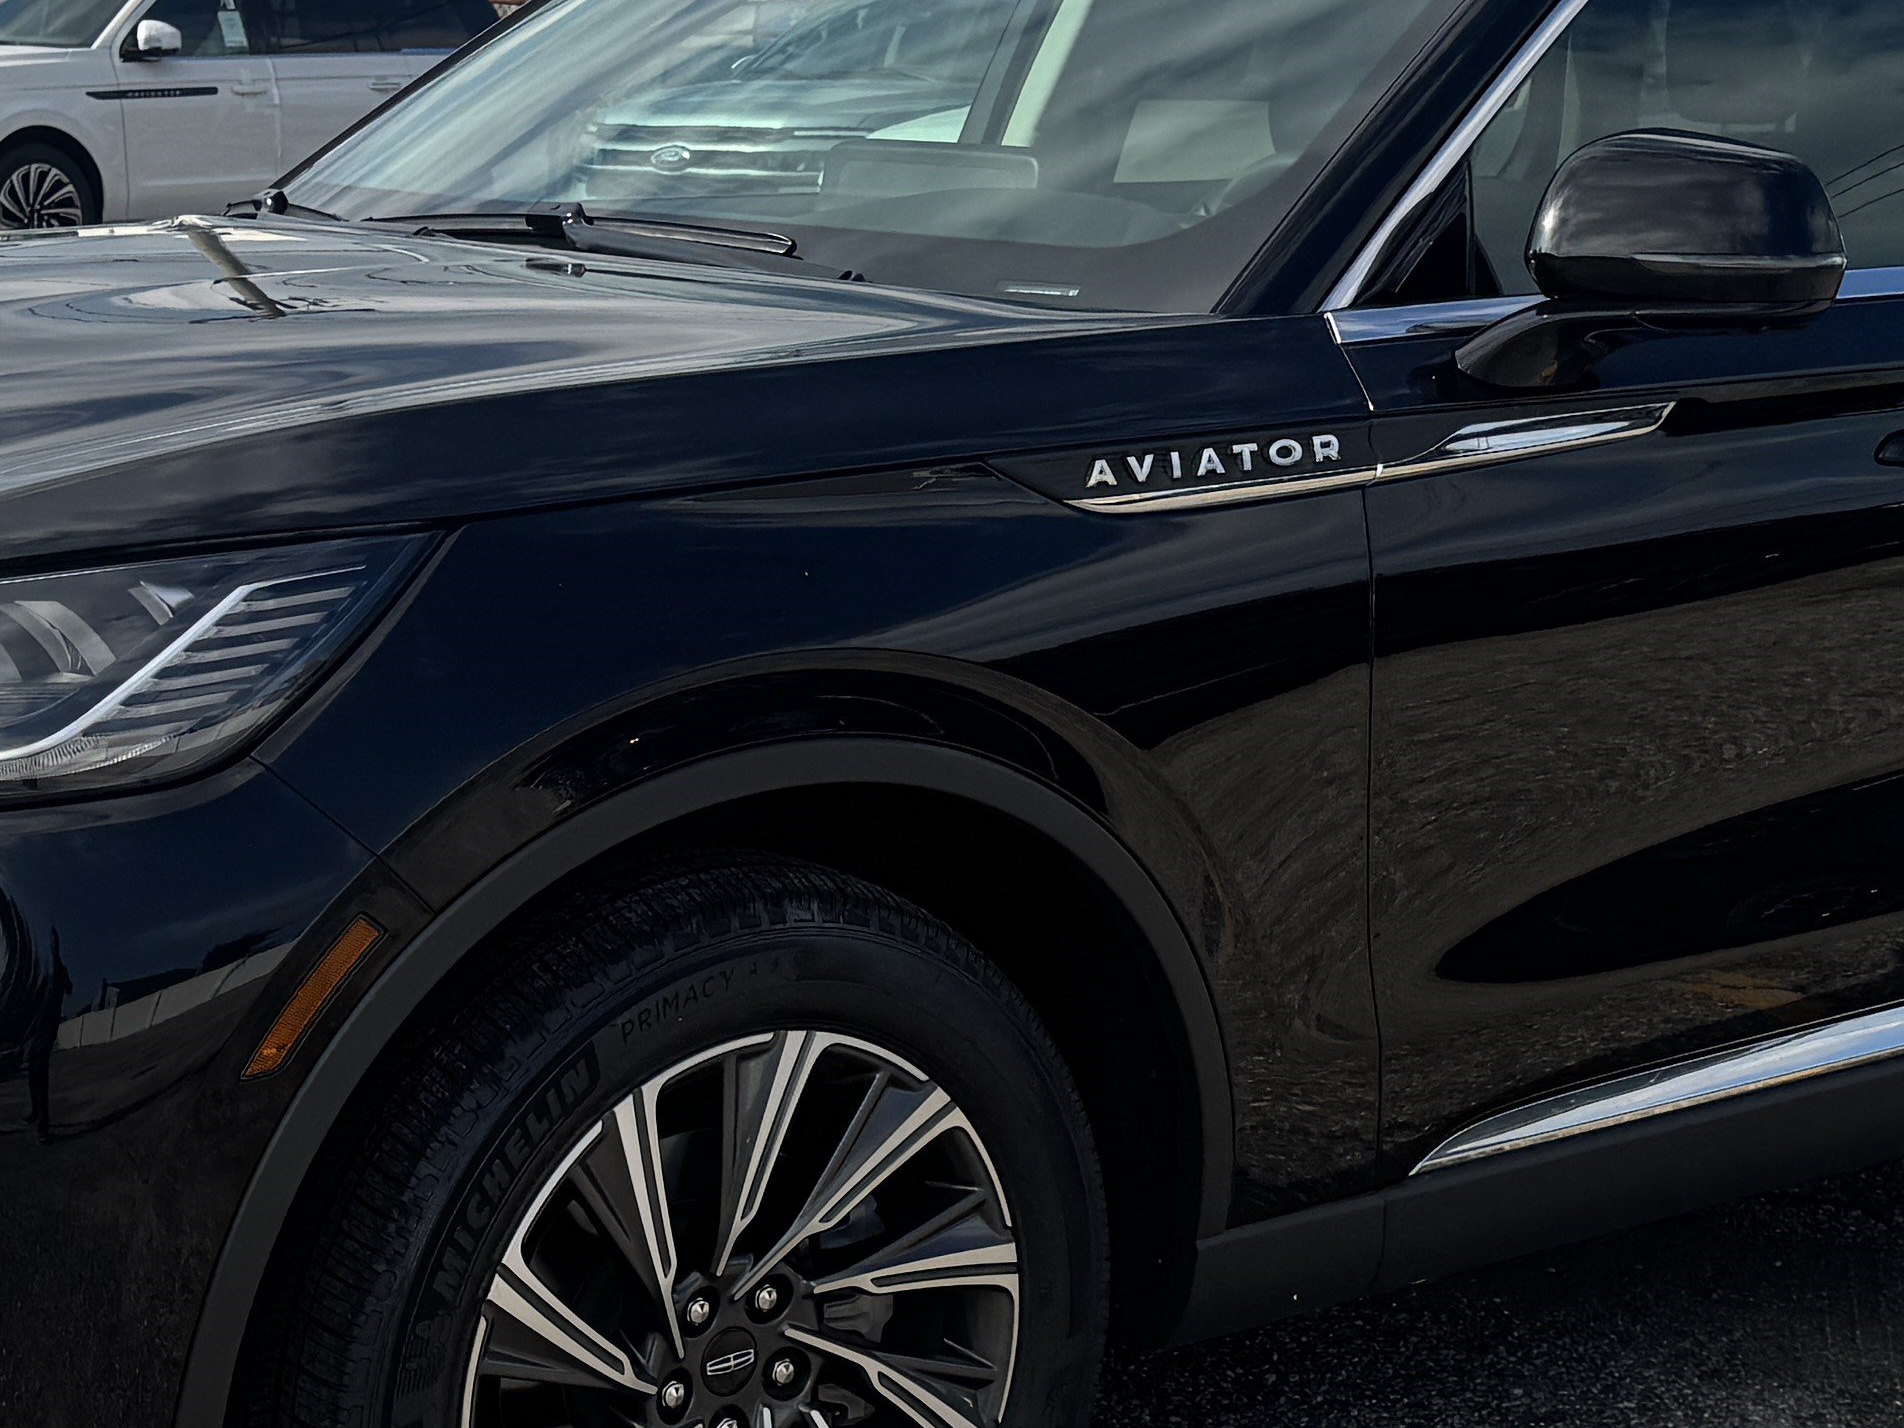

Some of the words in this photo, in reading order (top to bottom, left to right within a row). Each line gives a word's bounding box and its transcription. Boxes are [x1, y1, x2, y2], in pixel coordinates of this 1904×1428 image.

[1084, 434, 1342, 488] AVIATOR
[619, 968, 735, 1043] PRIMACY
[431, 1057, 591, 1305] MICHELIN
